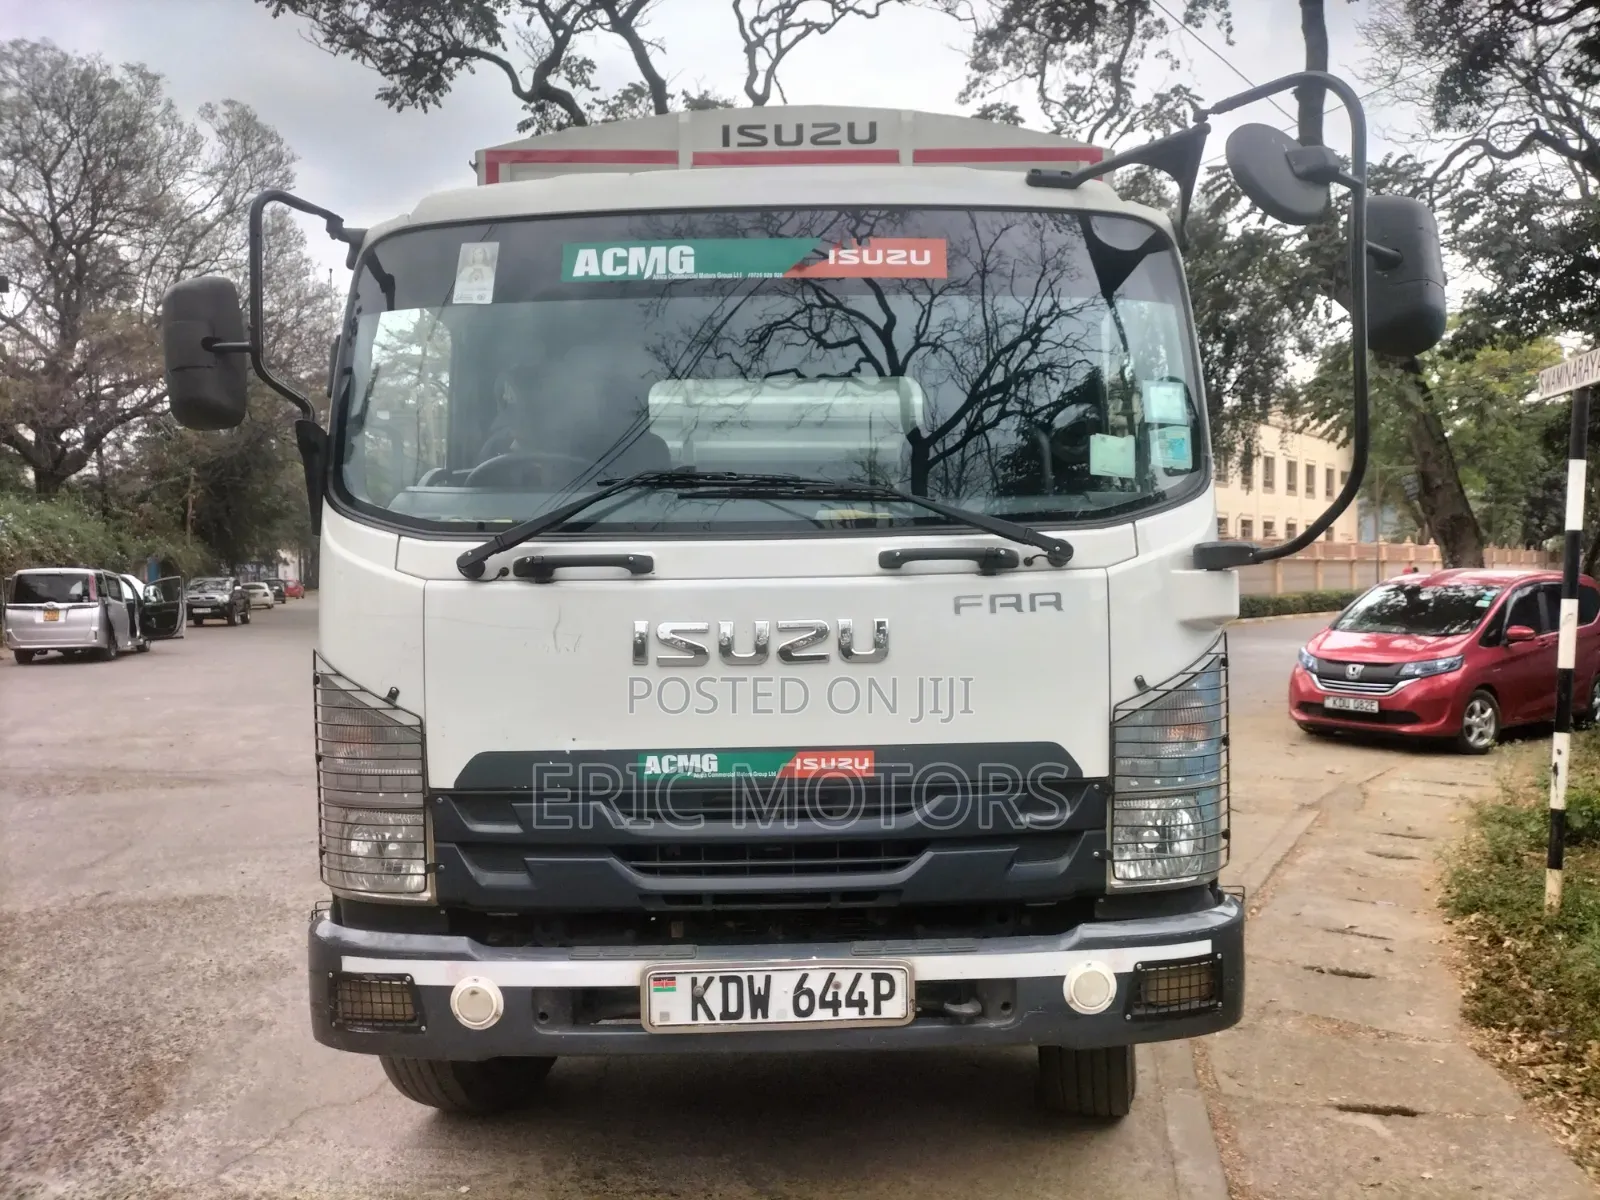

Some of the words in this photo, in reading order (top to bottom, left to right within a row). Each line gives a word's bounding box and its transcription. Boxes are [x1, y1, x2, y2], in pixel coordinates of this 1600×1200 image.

[722, 121, 877, 147] ISUZU
[572, 245, 695, 279] ACMG
[829, 249, 931, 265] ISUZU
[954, 592, 1064, 615] FRR
[632, 618, 890, 666] ISUZU
[644, 754, 718, 776] ACMG
[796, 757, 870, 771] ISUZU
[690, 974, 772, 1021] KDW
[792, 972, 896, 1018] 644P
